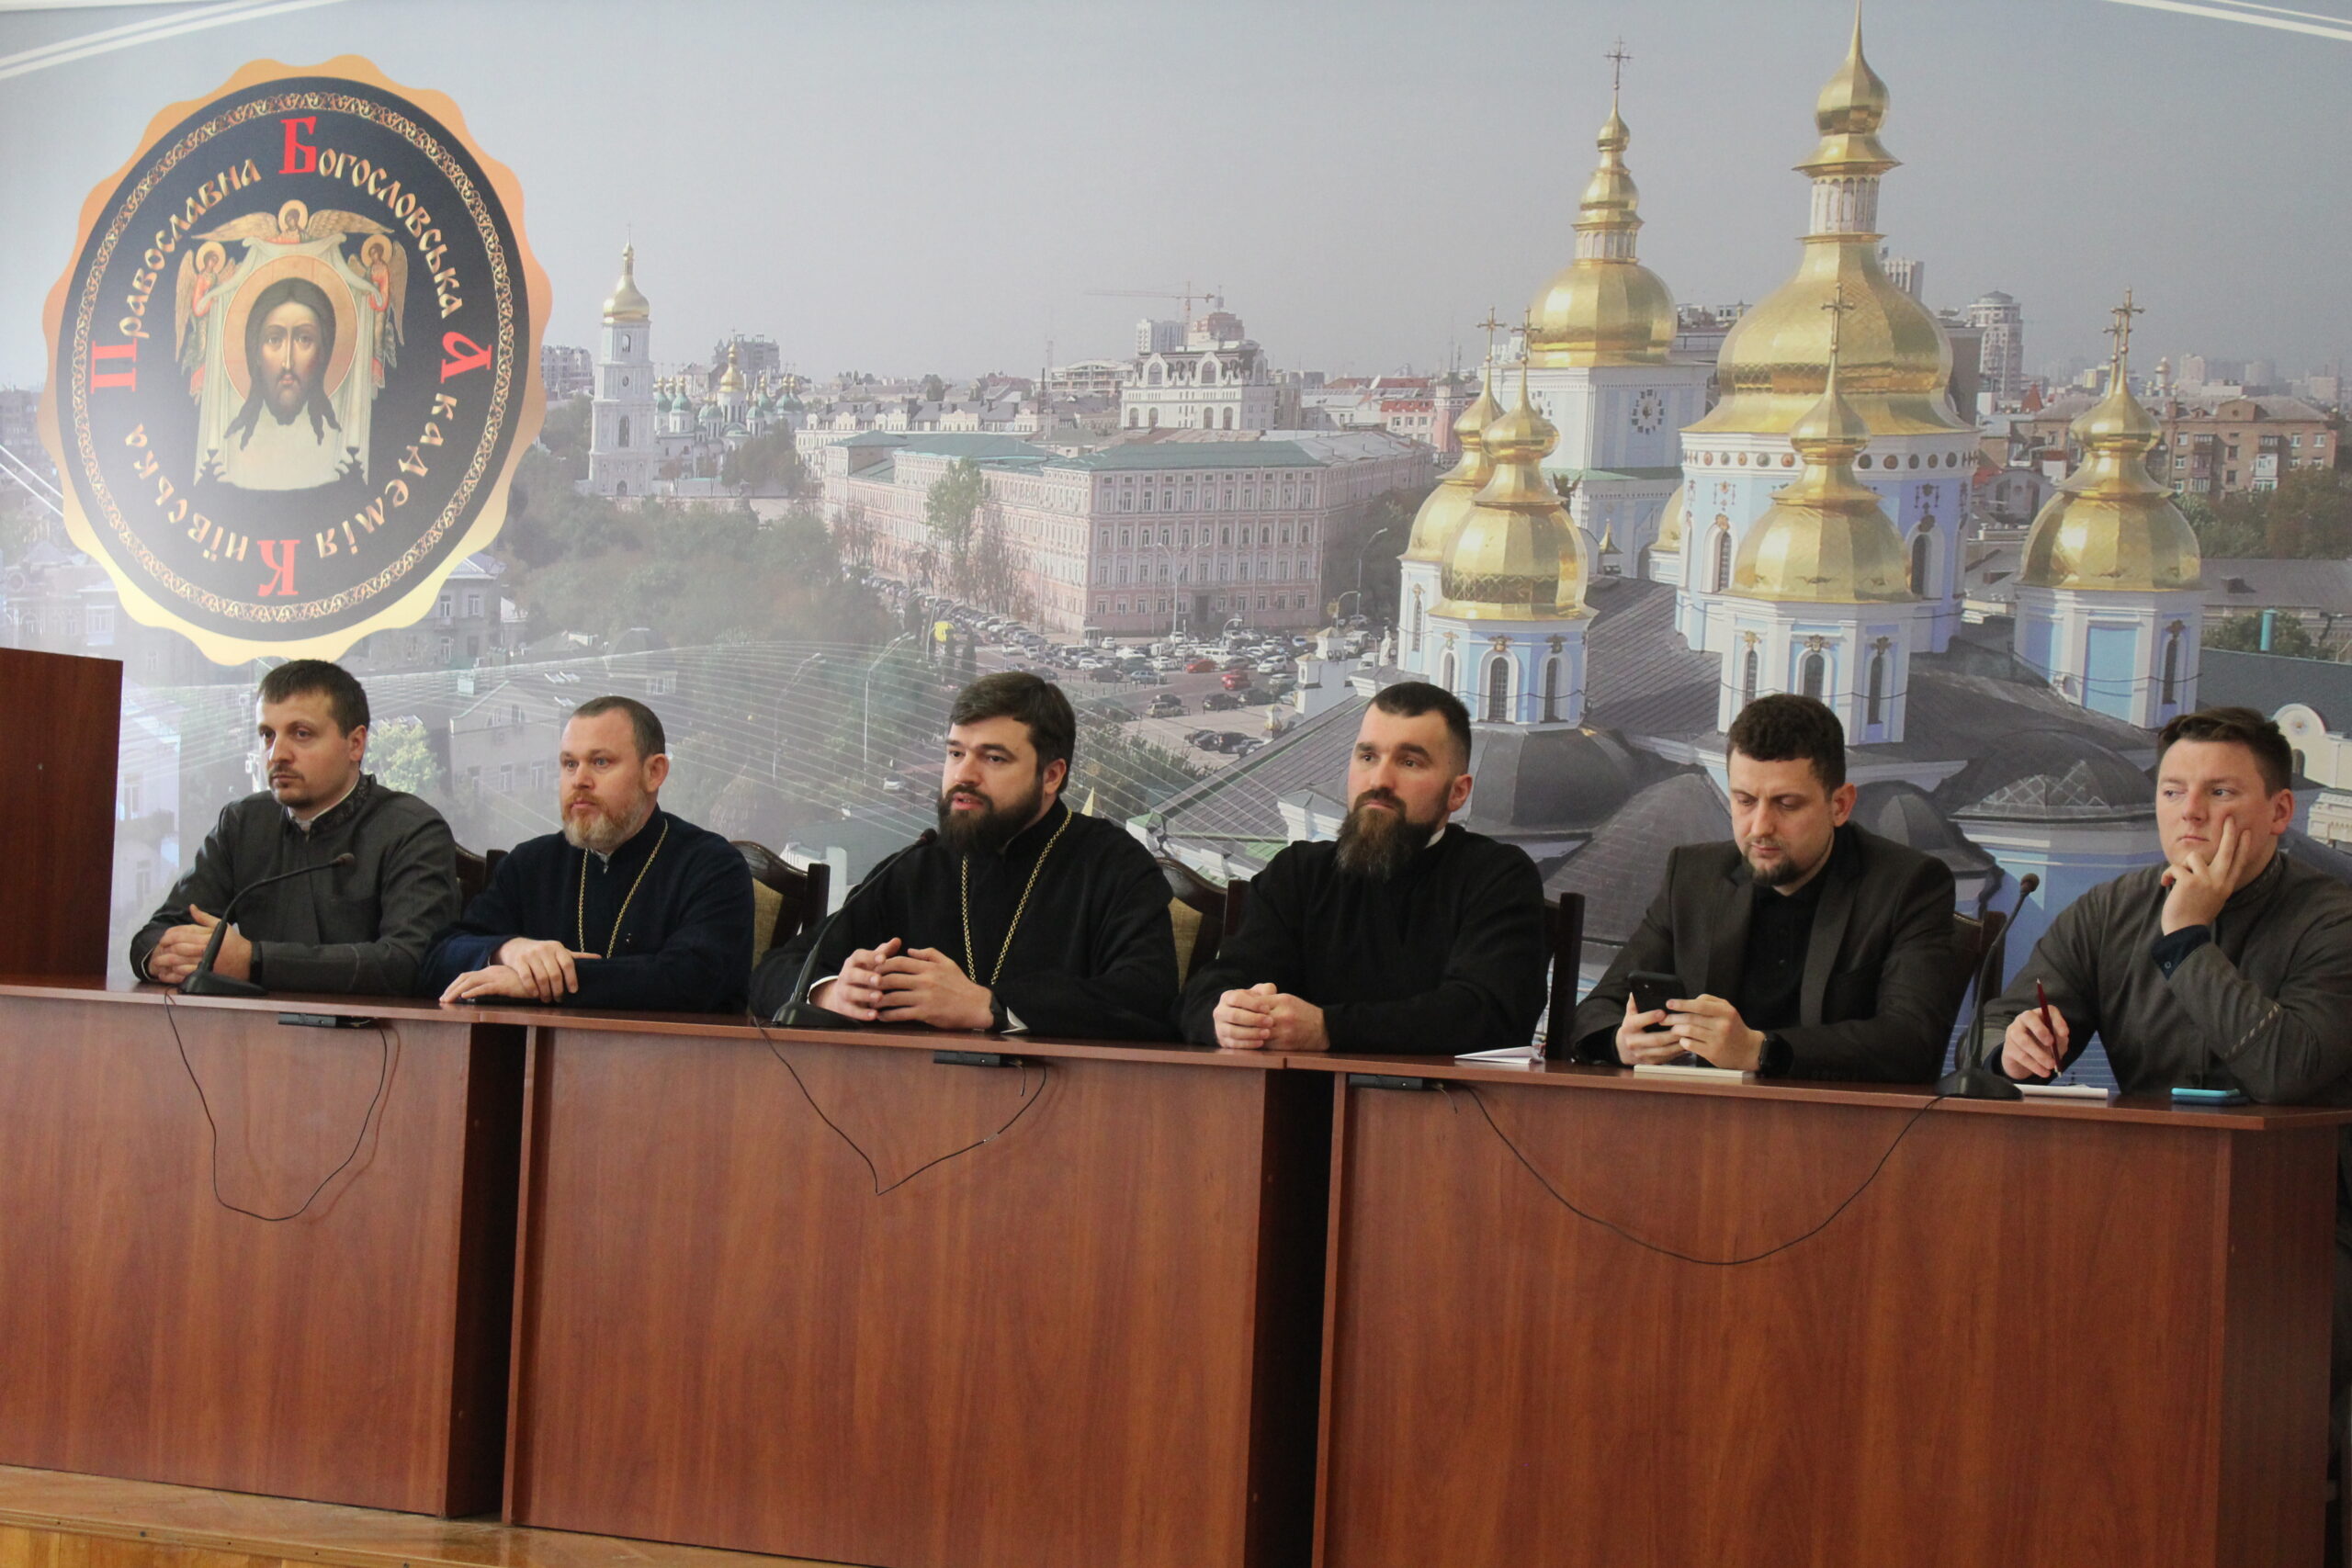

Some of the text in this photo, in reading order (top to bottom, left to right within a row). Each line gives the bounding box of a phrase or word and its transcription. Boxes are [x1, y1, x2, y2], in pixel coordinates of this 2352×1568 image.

[91, 159, 262, 393] Православна
[278, 116, 462, 319] Богословська
[315, 331, 492, 558] Академія
